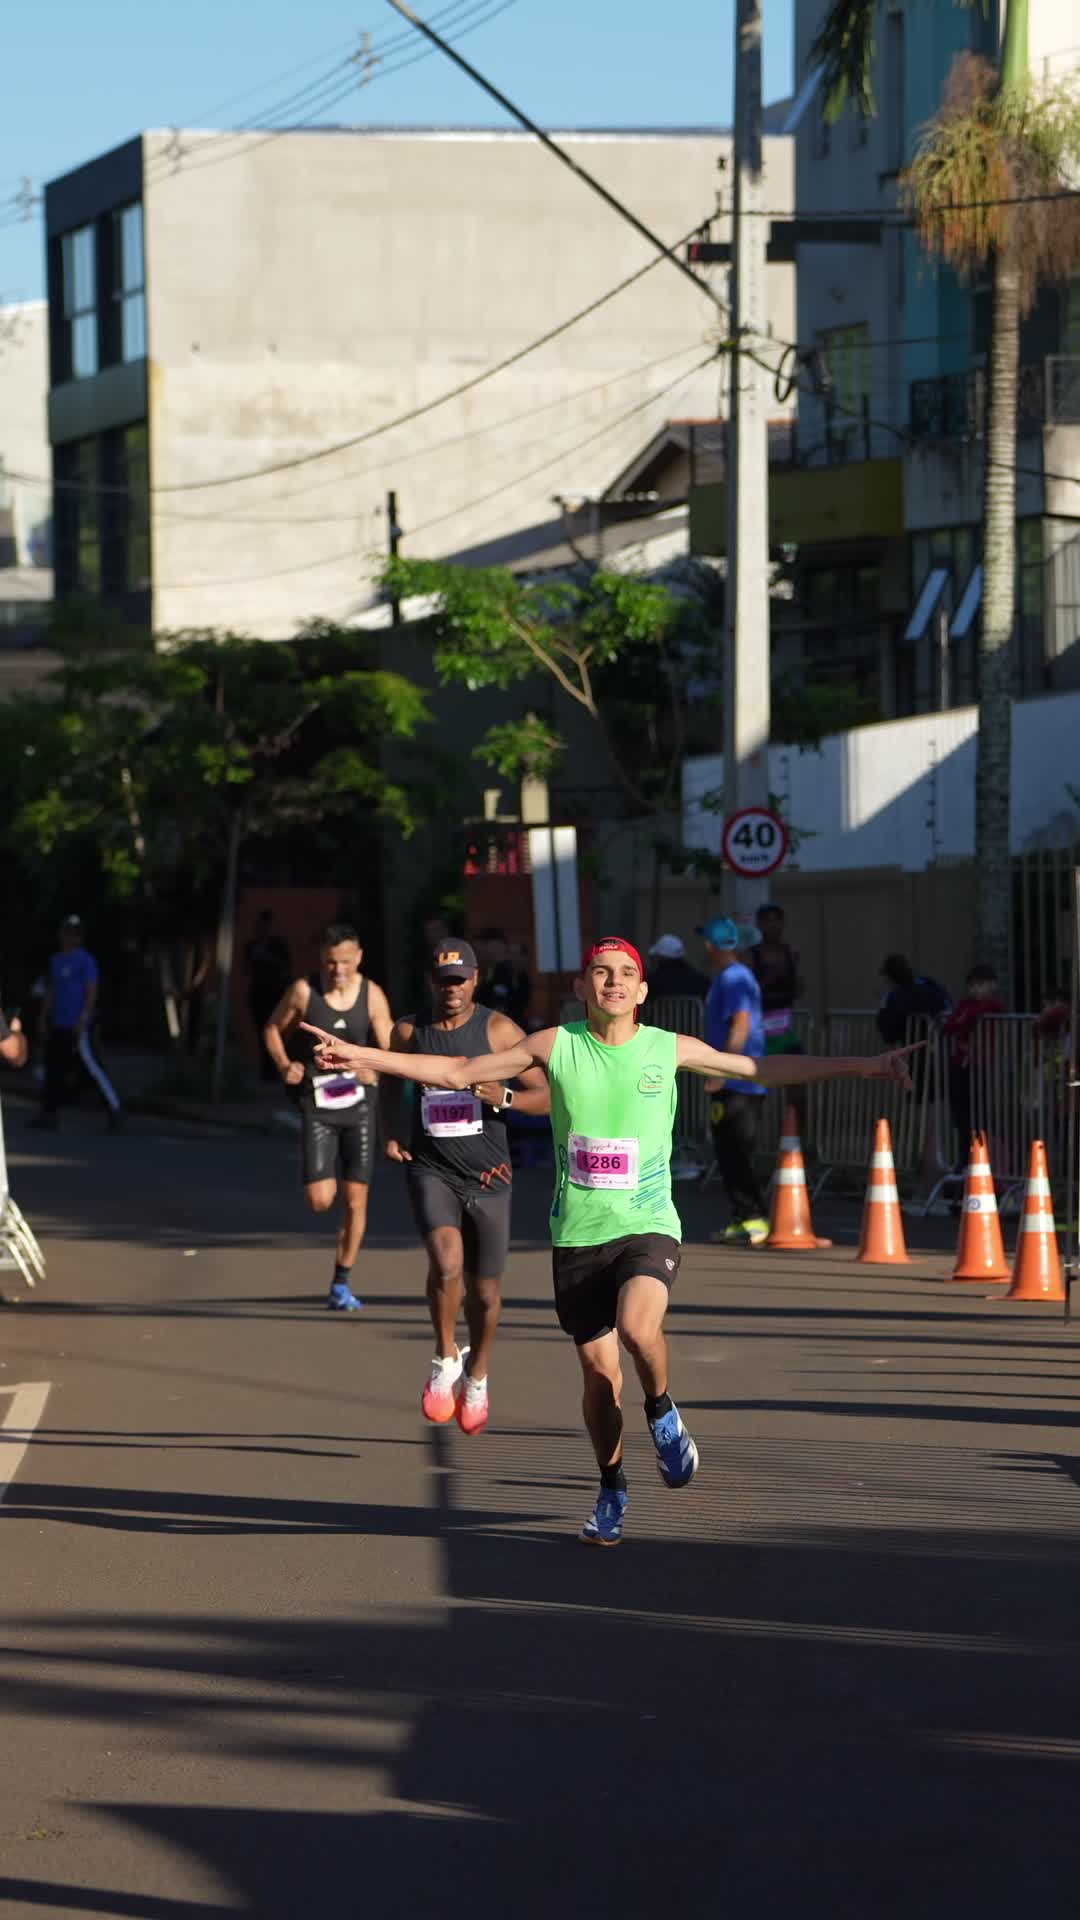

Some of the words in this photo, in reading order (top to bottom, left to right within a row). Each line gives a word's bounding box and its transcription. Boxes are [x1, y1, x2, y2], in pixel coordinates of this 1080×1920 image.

[733, 823, 775, 848] 40
[434, 1107, 465, 1121] 1197
[582, 1154, 621, 1169] 1286
